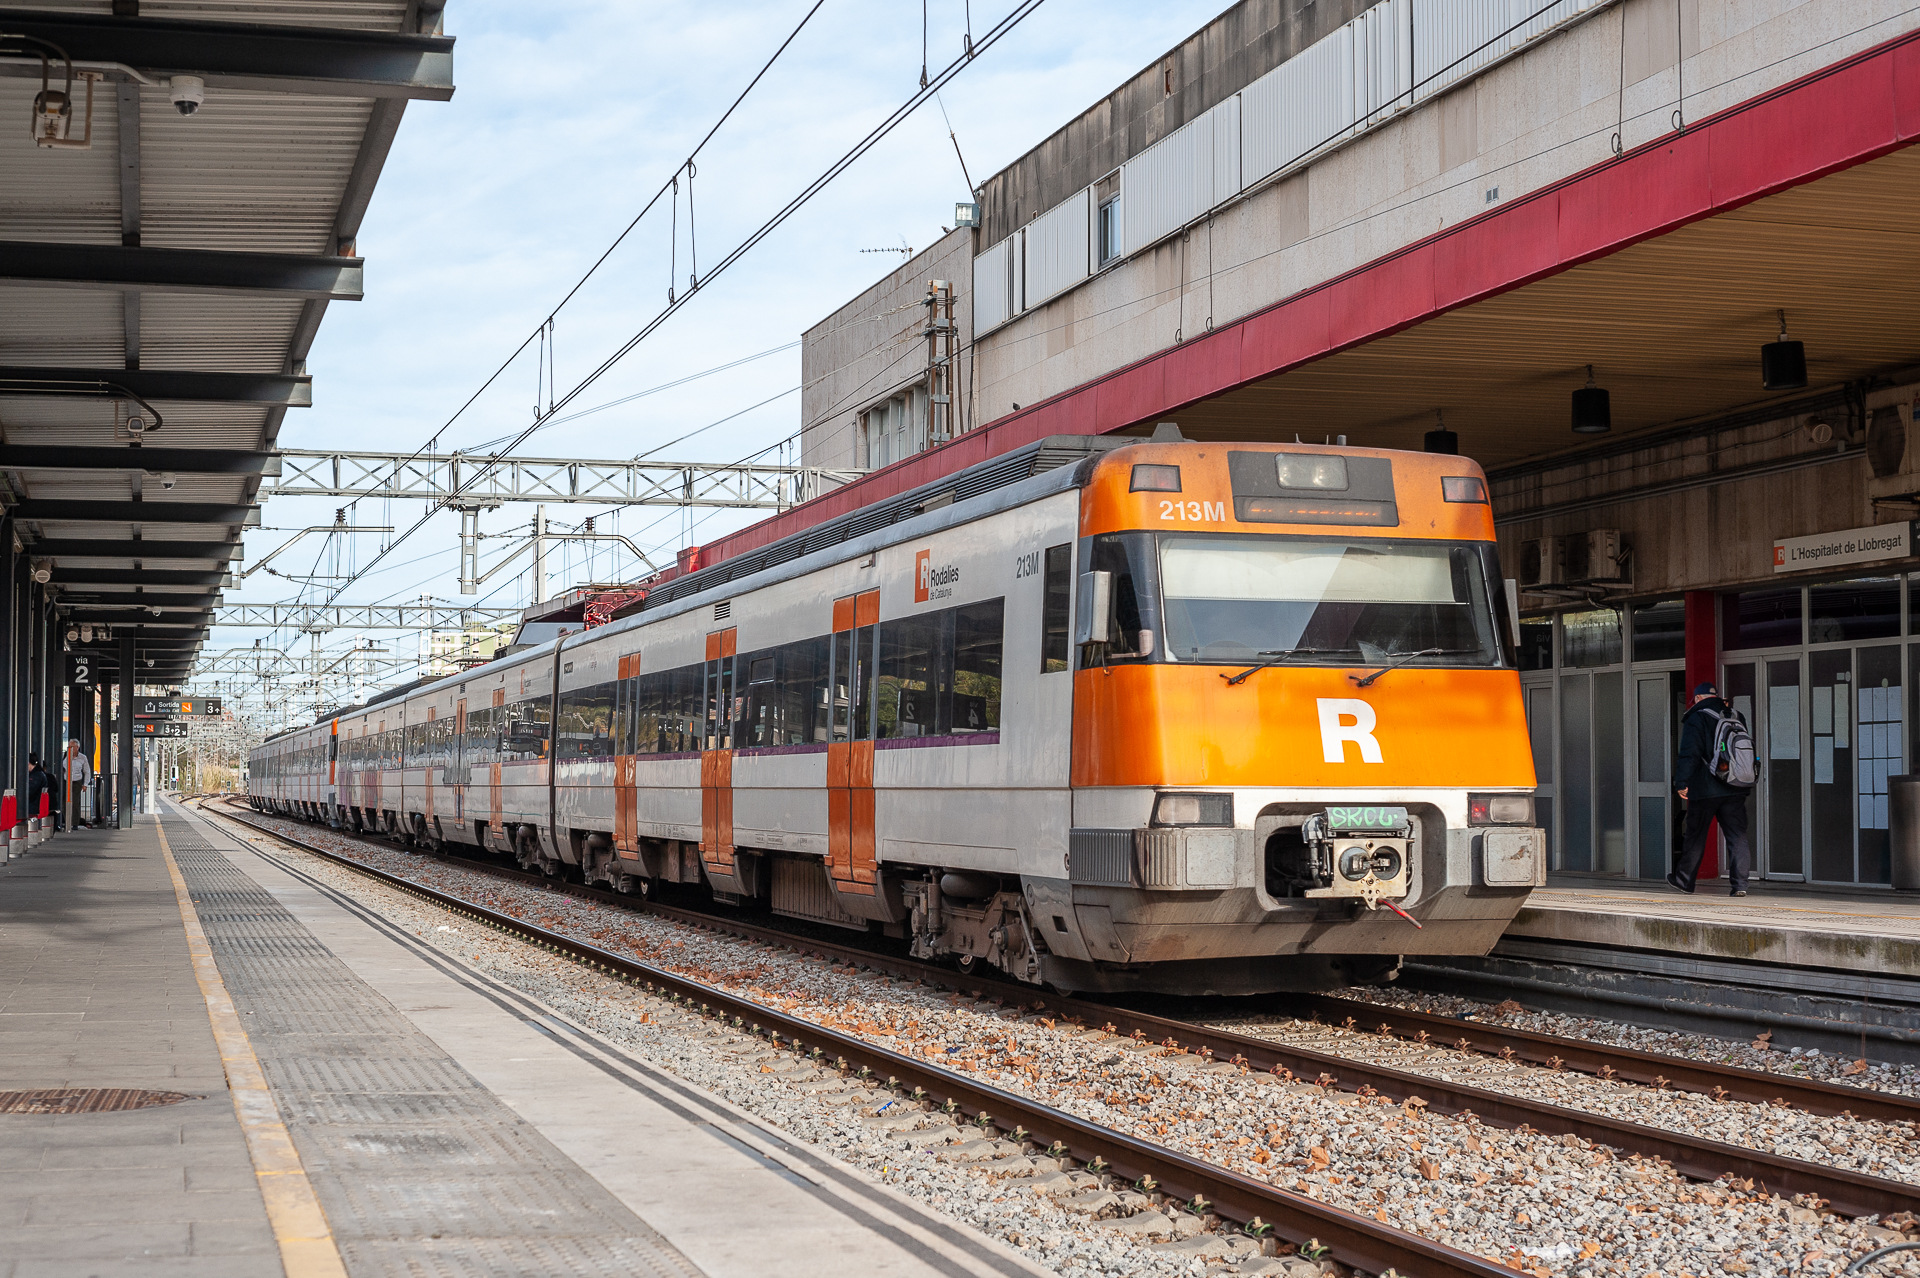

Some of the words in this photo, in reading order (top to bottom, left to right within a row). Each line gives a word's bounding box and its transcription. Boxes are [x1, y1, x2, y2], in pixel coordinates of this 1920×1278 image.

[1159, 500, 1226, 522] 213M
[1791, 543, 1842, 560] L'Hospitalet
[1844, 541, 1856, 553] de
[1857, 534, 1902, 551] Llobregat
[1016, 551, 1040, 579] 213M
[930, 564, 959, 587] Rodalies
[930, 590, 935, 600] de
[935, 586, 952, 599] Catalunya
[75, 656, 88, 664] via
[75, 665, 89, 683] 2
[207, 705, 214, 714] 3
[174, 728, 181, 736] 2
[1316, 698, 1384, 763] R
